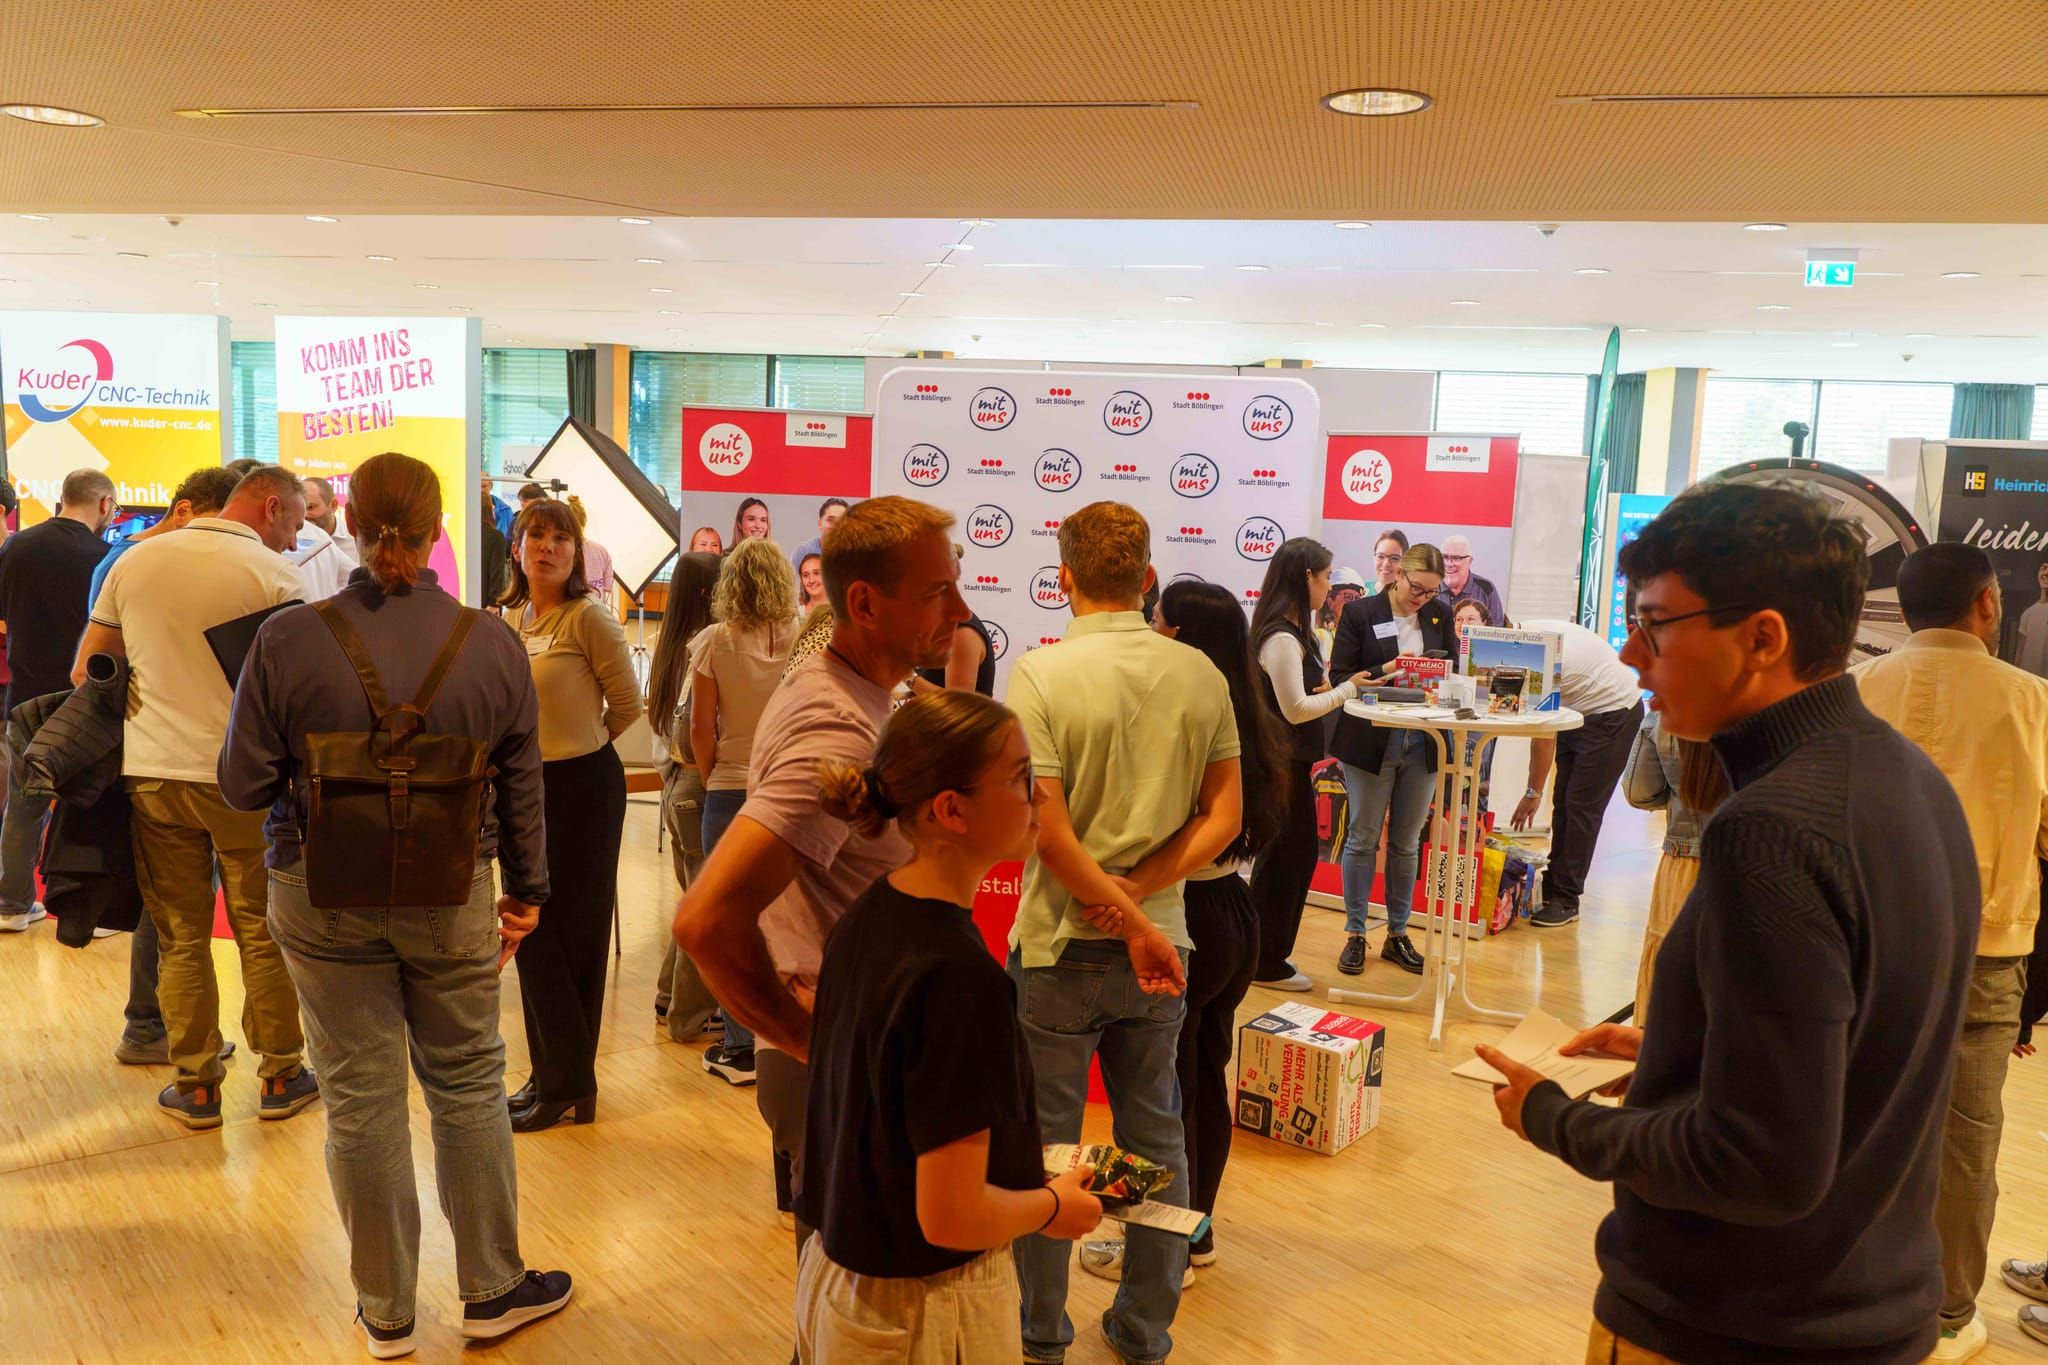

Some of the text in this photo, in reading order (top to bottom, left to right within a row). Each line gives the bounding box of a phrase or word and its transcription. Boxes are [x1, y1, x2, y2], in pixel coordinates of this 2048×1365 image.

[301, 329, 411, 374] KOMM INS
[18, 368, 91, 390] Kuder
[320, 358, 435, 403] TEAM DER
[98, 386, 210, 405] CNC-Technik
[903, 393, 952, 403] Stadt Böblingen
[1035, 397, 1085, 407] Stadt Böblingen
[977, 396, 1006, 412] mit
[1113, 400, 1141, 416] mit
[1172, 401, 1224, 411] Stadt Böblingen
[303, 400, 394, 440] BESTEN!
[977, 410, 1007, 424] uns
[1112, 413, 1142, 428] uns
[1252, 405, 1281, 421] mit
[100, 417, 211, 431] www.kuder-cnc.de
[1250, 419, 1282, 433] uns
[710, 433, 743, 450] mit
[709, 452, 744, 465] uns
[911, 452, 938, 468] mit
[1435, 454, 1451, 462] Stadt
[910, 466, 940, 480] uns
[967, 467, 1016, 477] Stadt Böblingen
[1042, 458, 1070, 474] mit
[1179, 462, 1208, 478] mit
[1352, 459, 1383, 478] mit
[1041, 472, 1072, 486] uns
[1100, 473, 1150, 483] Stadt Böblingen
[1177, 476, 1209, 491] uns
[1238, 478, 1290, 489] Stadt Böblingen
[1350, 478, 1383, 493] uns
[1965, 472, 1986, 490] HS
[1994, 478, 2048, 492] Heinric
[975, 513, 1003, 529] mit
[974, 527, 1004, 542] uns
[1031, 529, 1048, 537] Stadt
[1166, 535, 1217, 546] Stadt Böblingen
[1246, 525, 1274, 542] mit
[1244, 539, 1275, 554] uns
[963, 583, 1012, 594] Stadt Böblingen
[1039, 576, 1061, 588] mi
[1037, 591, 1067, 602] uns
[1473, 628, 1515, 640] Ravensburger
[1401, 660, 1444, 669] CITY-MEMO
[1278, 1043, 1293, 1119] VERWALTUNG
[1293, 1046, 1306, 1105] MEHR ALS
